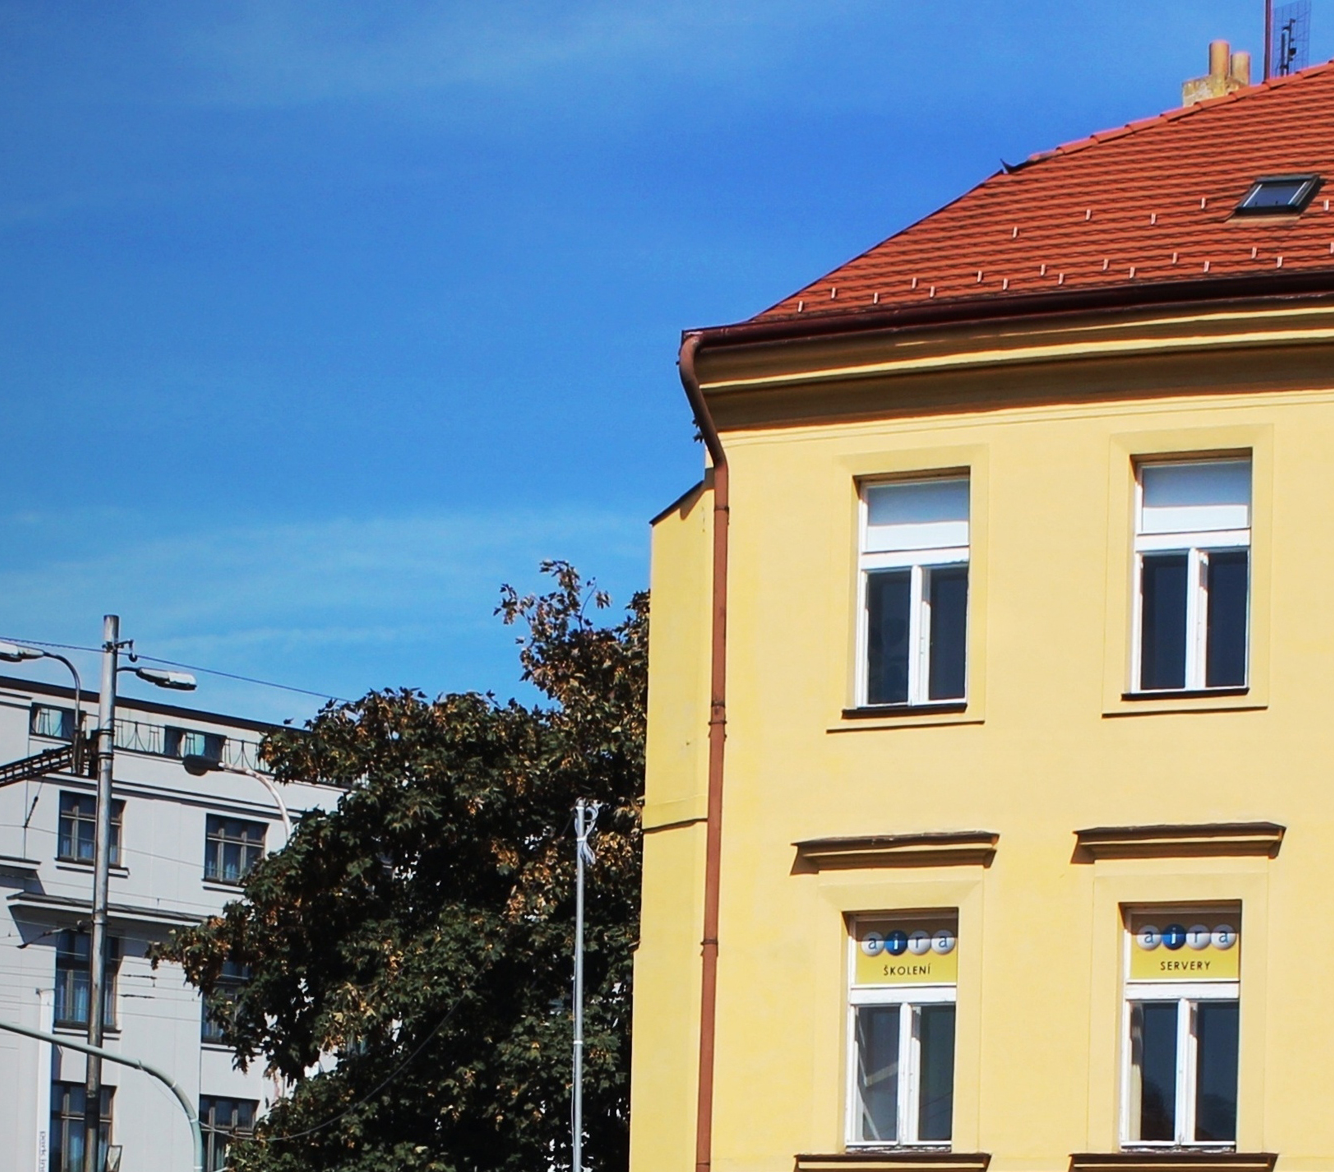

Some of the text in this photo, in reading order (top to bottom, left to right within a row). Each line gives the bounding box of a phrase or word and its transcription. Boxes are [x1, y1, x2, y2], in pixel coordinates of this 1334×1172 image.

[867, 932, 949, 951] aira
[1143, 926, 1229, 945] aira
[883, 962, 931, 976] ŠKOLENÍ
[1160, 961, 1211, 971] SERVERY
